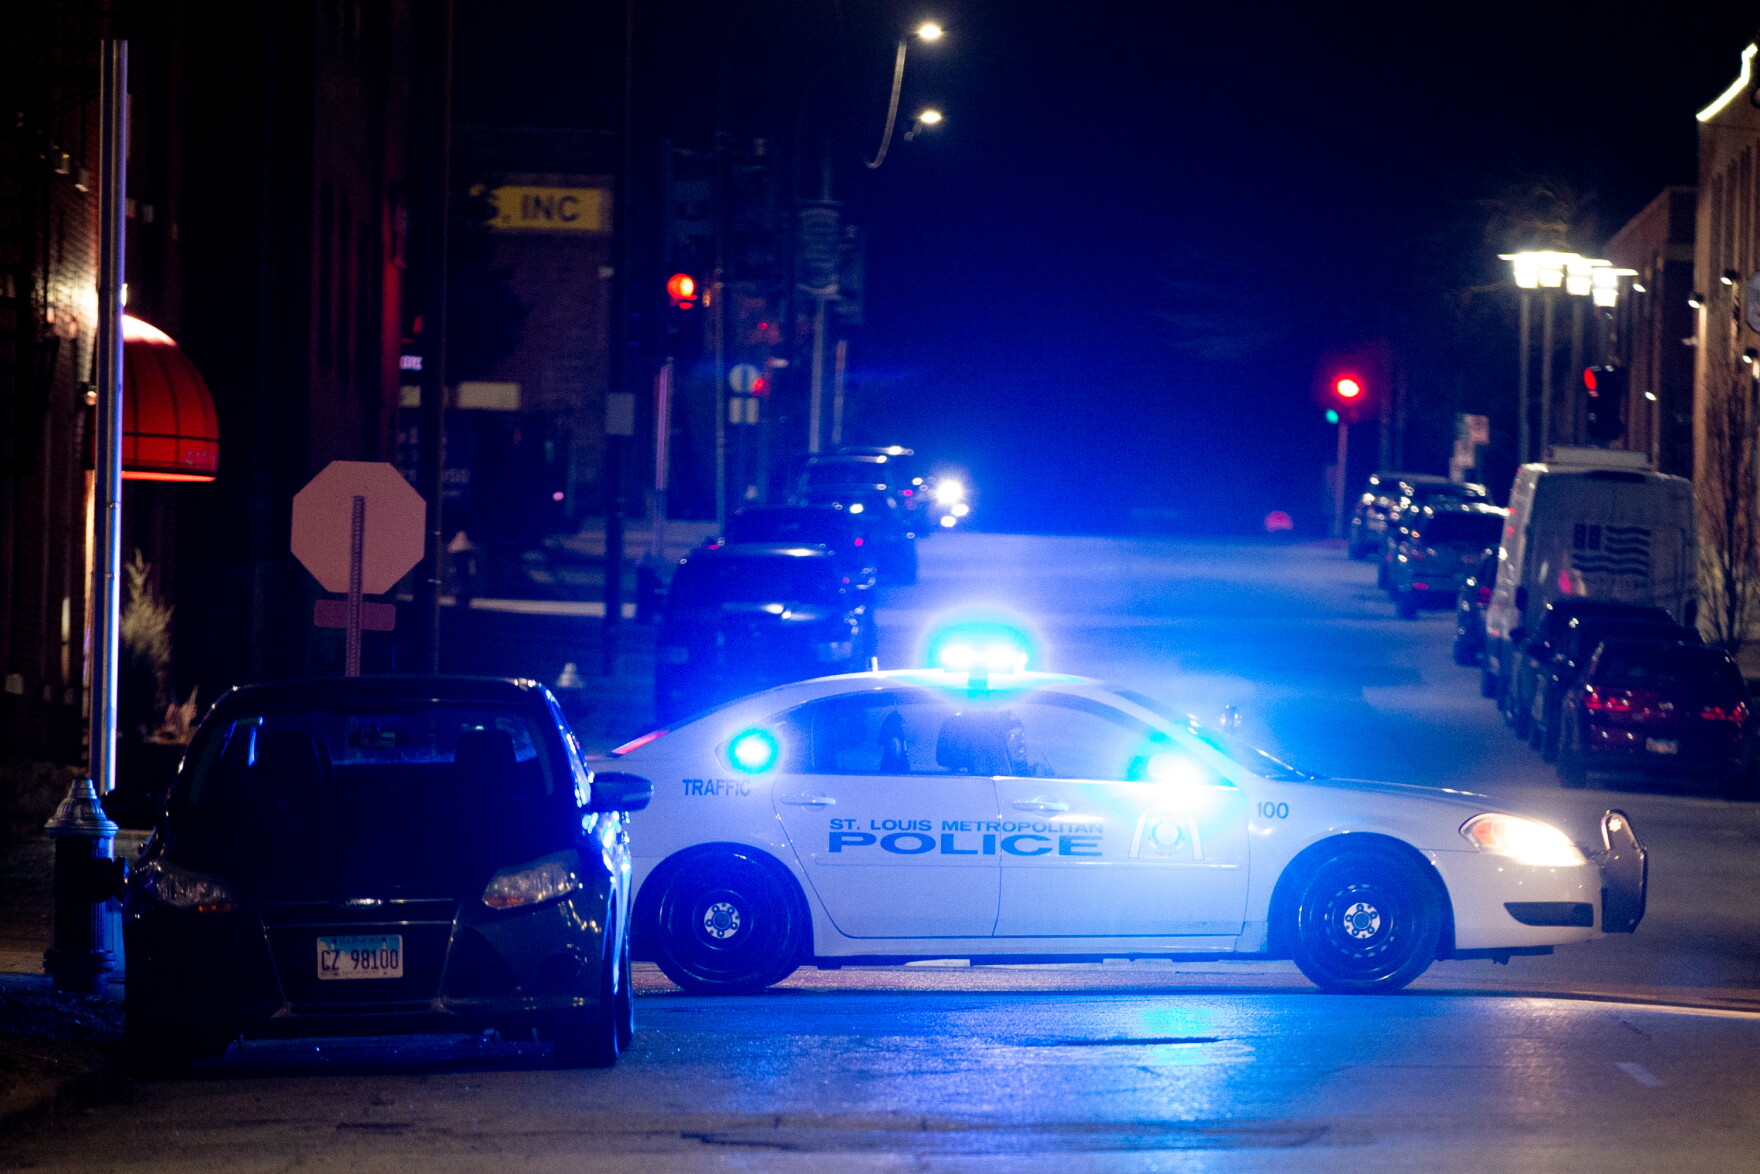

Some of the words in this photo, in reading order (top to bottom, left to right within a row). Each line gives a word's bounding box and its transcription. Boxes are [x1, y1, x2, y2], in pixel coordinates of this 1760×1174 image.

[521, 194, 581, 222] INC
[682, 779, 751, 796] TRAFFIC
[1256, 801, 1290, 819] 100
[829, 818, 860, 831] ST.
[870, 818, 932, 832] LOUIS
[942, 819, 1104, 833] METROPOLITAN
[828, 831, 1104, 856] POLICE
[321, 949, 340, 971] CZ
[350, 948, 399, 970] 98100
